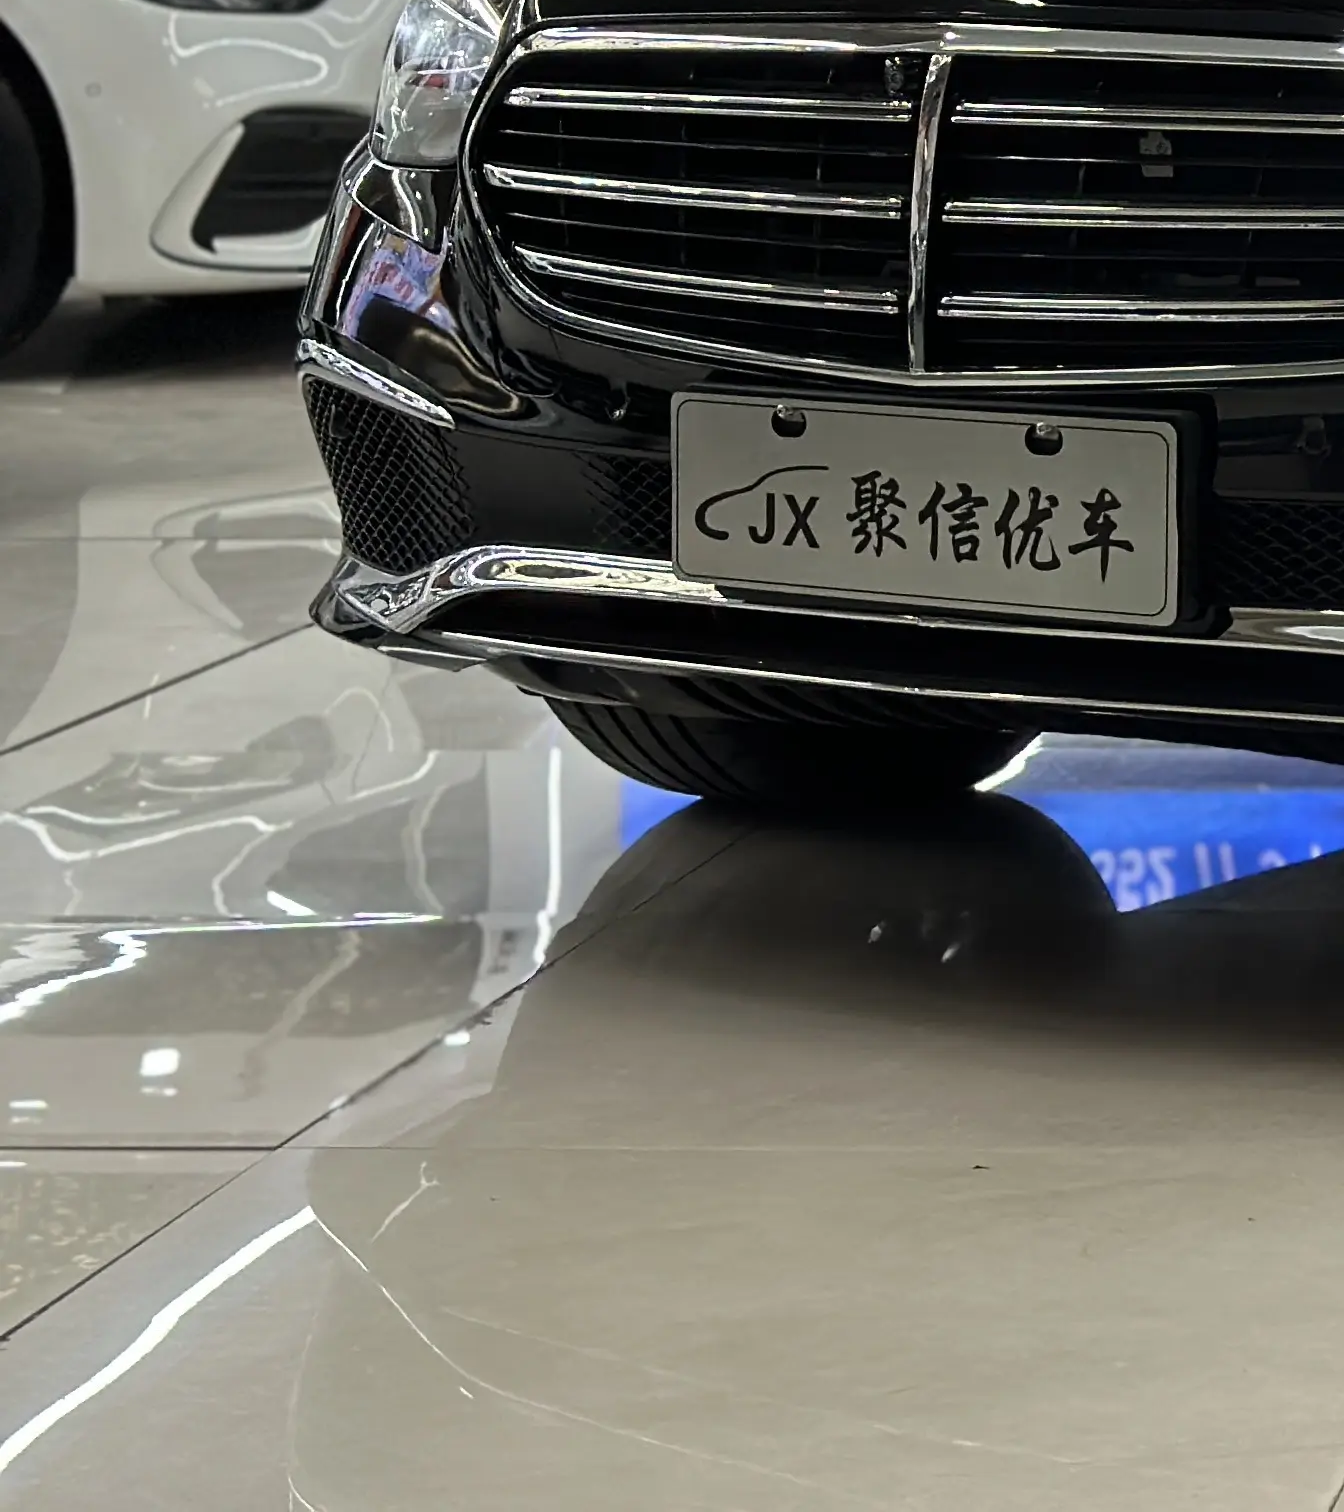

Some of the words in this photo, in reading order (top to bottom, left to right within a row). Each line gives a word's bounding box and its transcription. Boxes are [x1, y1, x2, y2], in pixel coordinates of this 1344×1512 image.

[747, 491, 821, 550] JX
[846, 469, 1135, 583] 聚信优车
